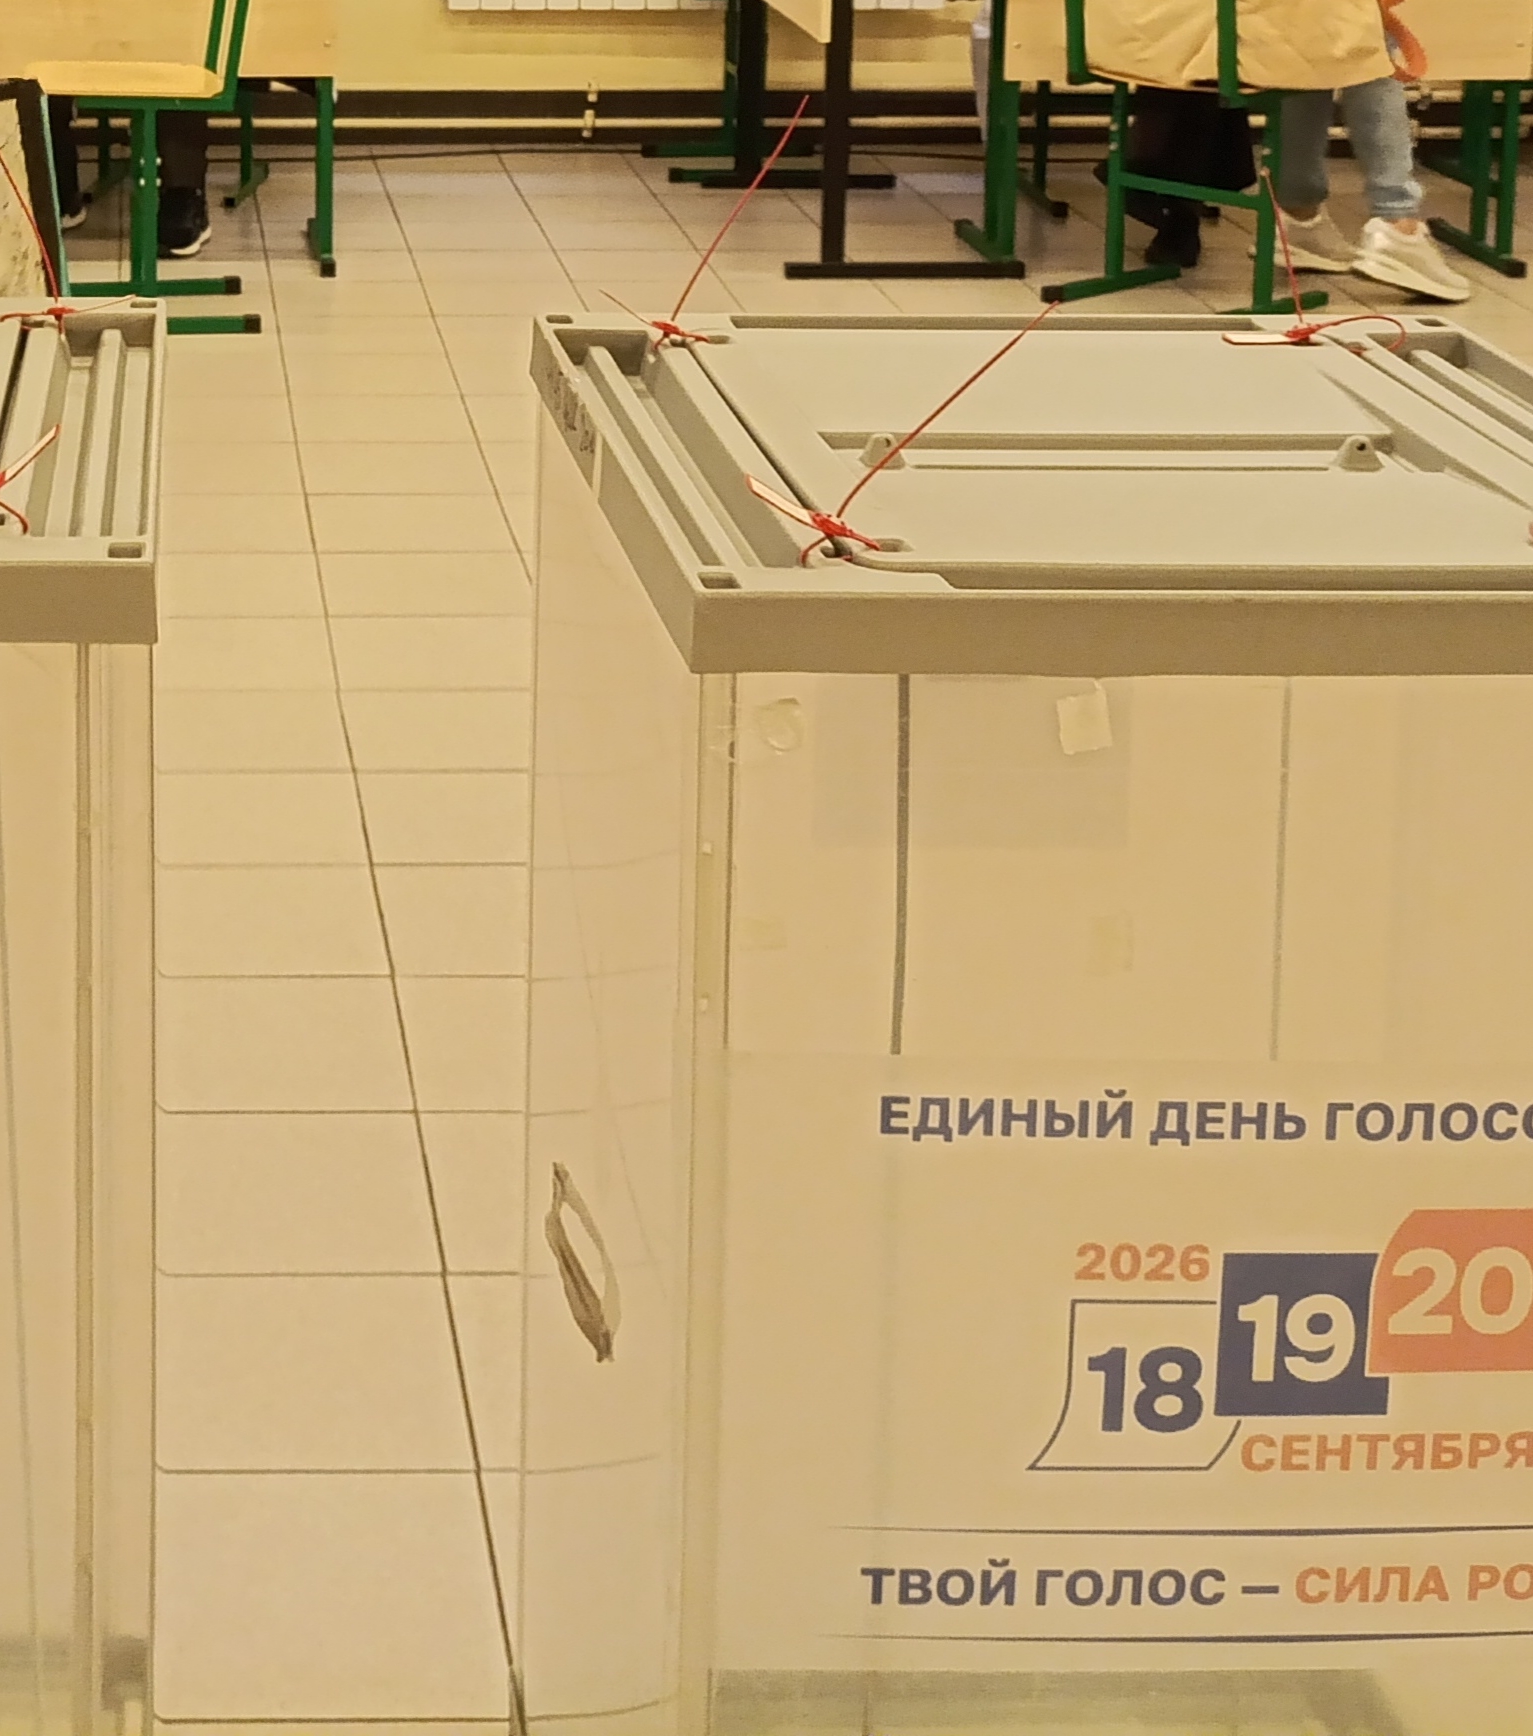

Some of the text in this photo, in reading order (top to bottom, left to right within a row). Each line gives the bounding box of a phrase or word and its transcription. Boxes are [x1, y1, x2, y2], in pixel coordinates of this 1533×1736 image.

[880, 1089, 1133, 1142] ЕДИНЫЙ
[1150, 1101, 1306, 1146] ДЕНЬ
[1074, 1242, 1211, 1282] 2026
[1087, 1246, 1533, 1433] 18 19 20
[1241, 1431, 1533, 1472] СЕНТЯБРЯ
[861, 1558, 1017, 1606] ТВОЙ
[1036, 1568, 1226, 1606] ГОЛОС
[1295, 1565, 1450, 1603] СИЛА
[1468, 1563, 1533, 1601] РО
